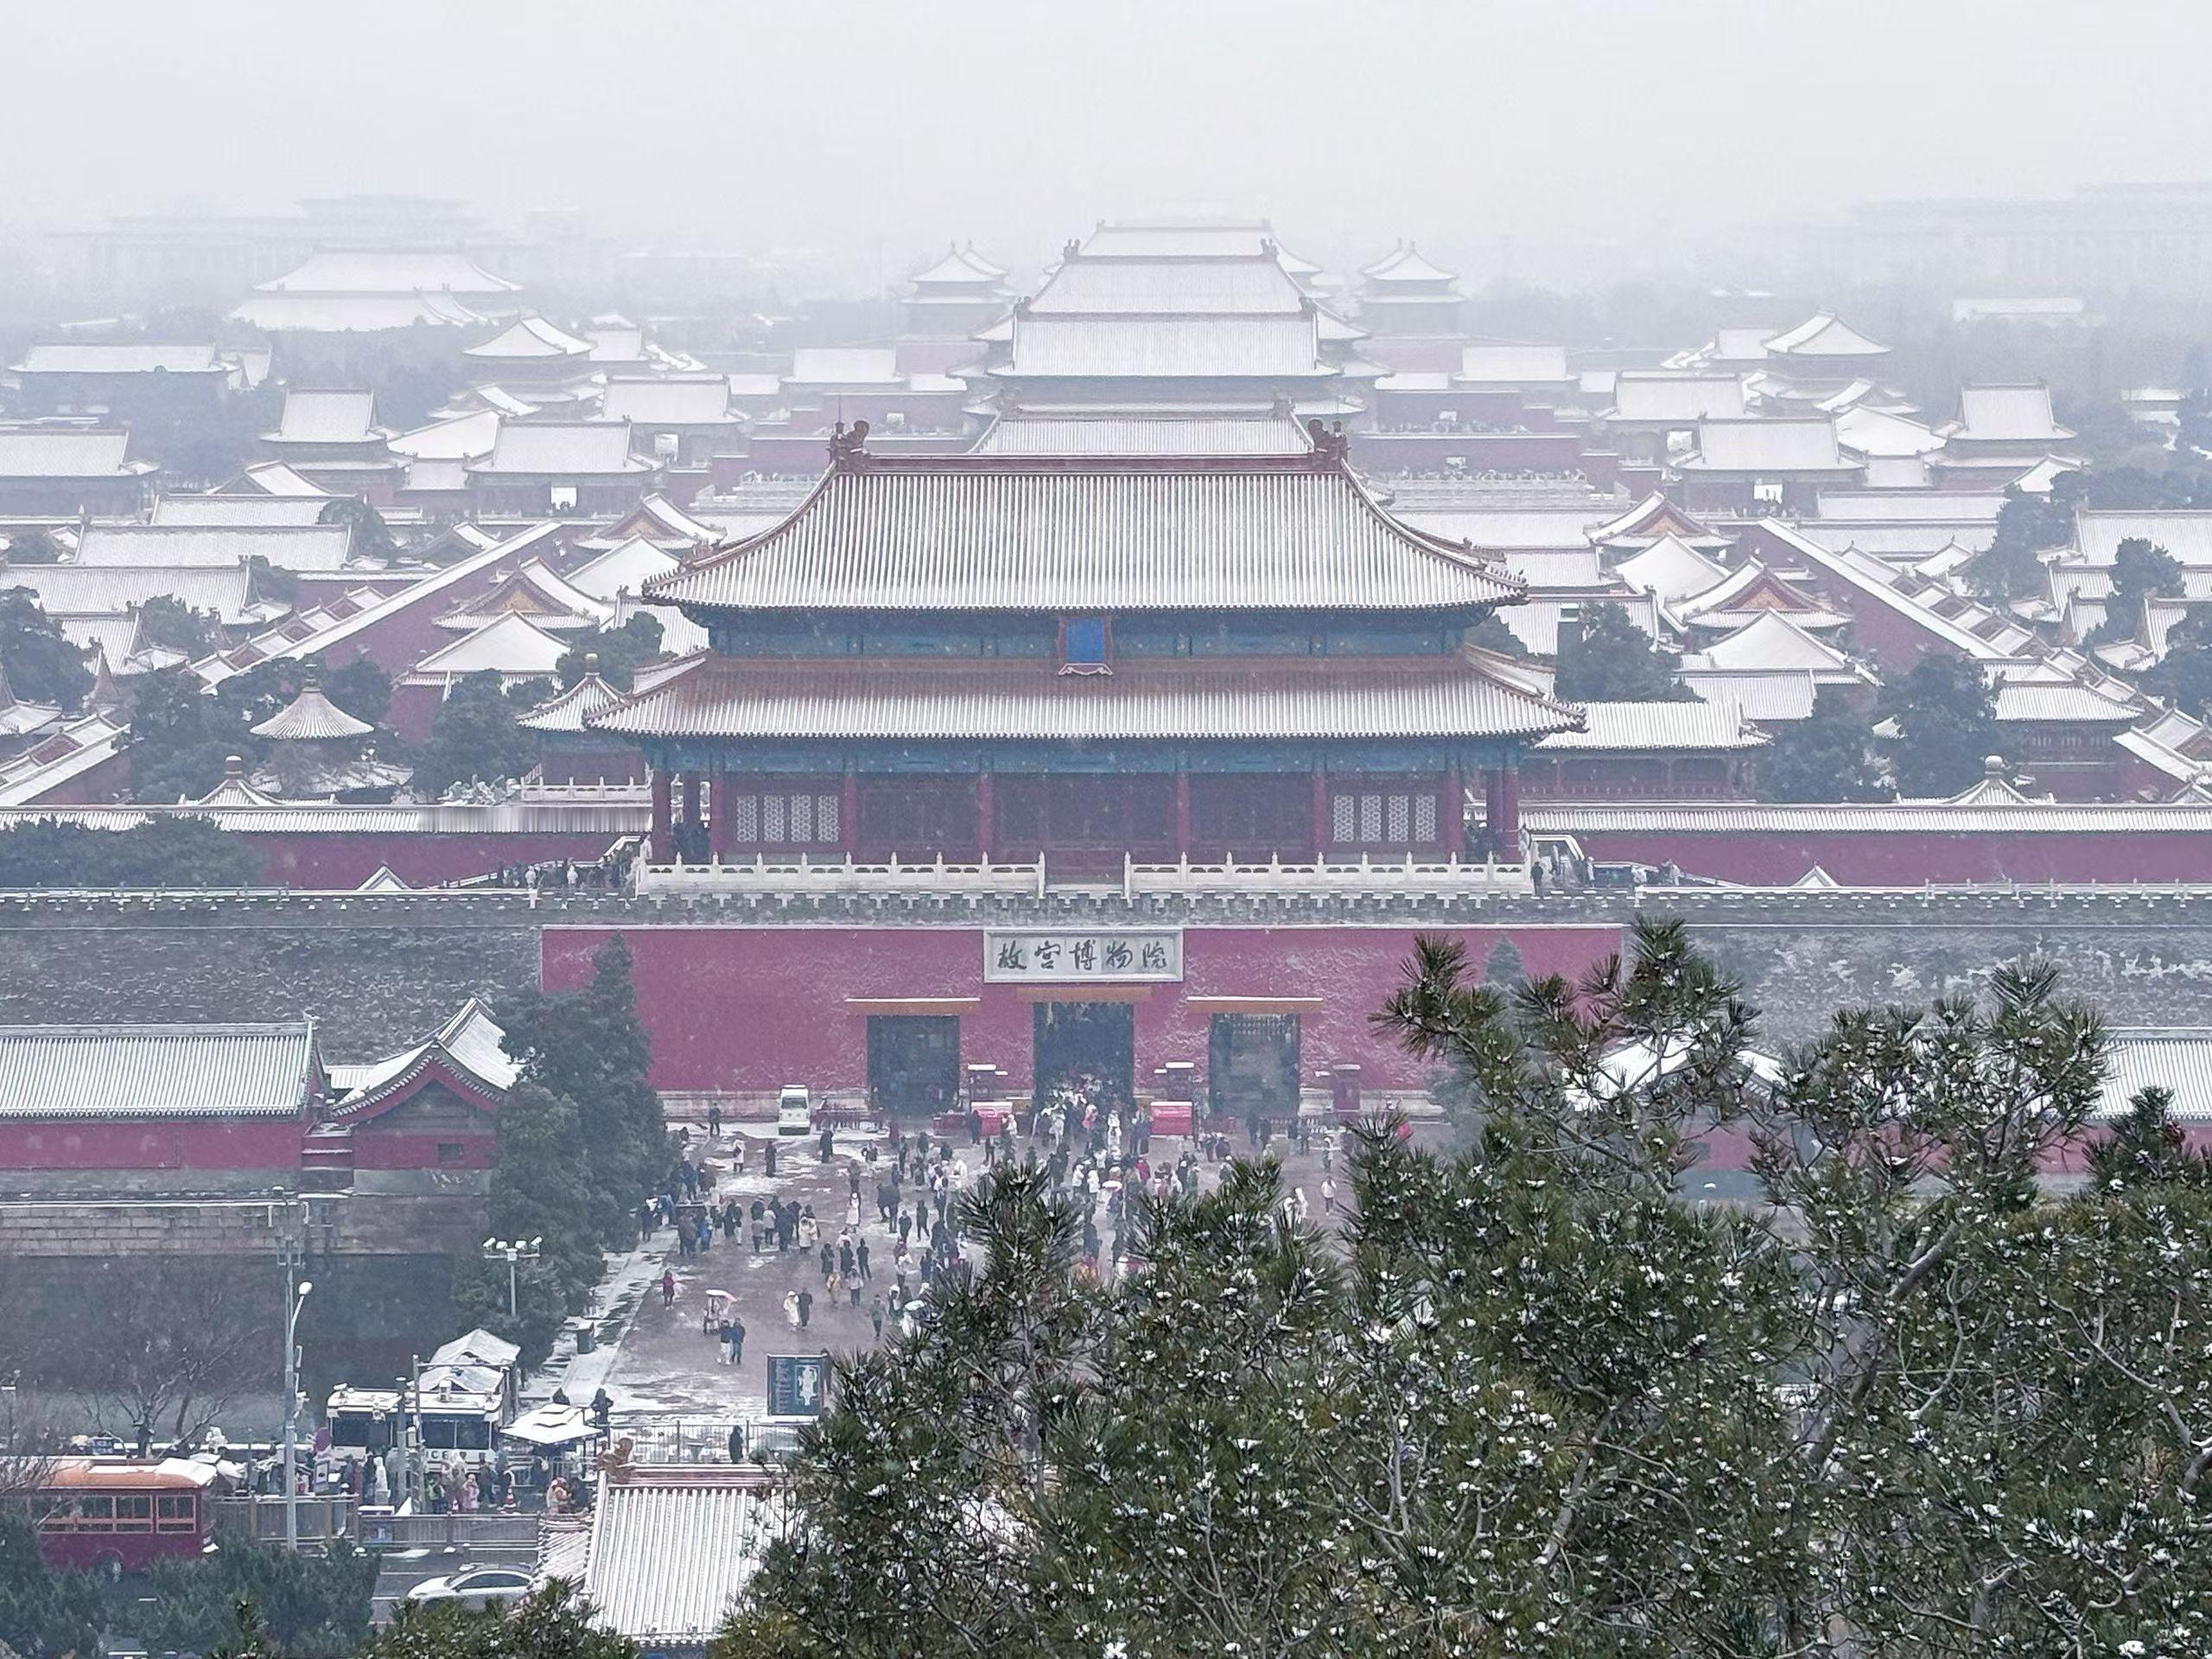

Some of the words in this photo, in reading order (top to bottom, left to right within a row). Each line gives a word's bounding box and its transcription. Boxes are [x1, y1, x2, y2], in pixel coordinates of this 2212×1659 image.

[997, 939, 1167, 970] 故宫博物院
[425, 1451, 449, 1460] ICE
